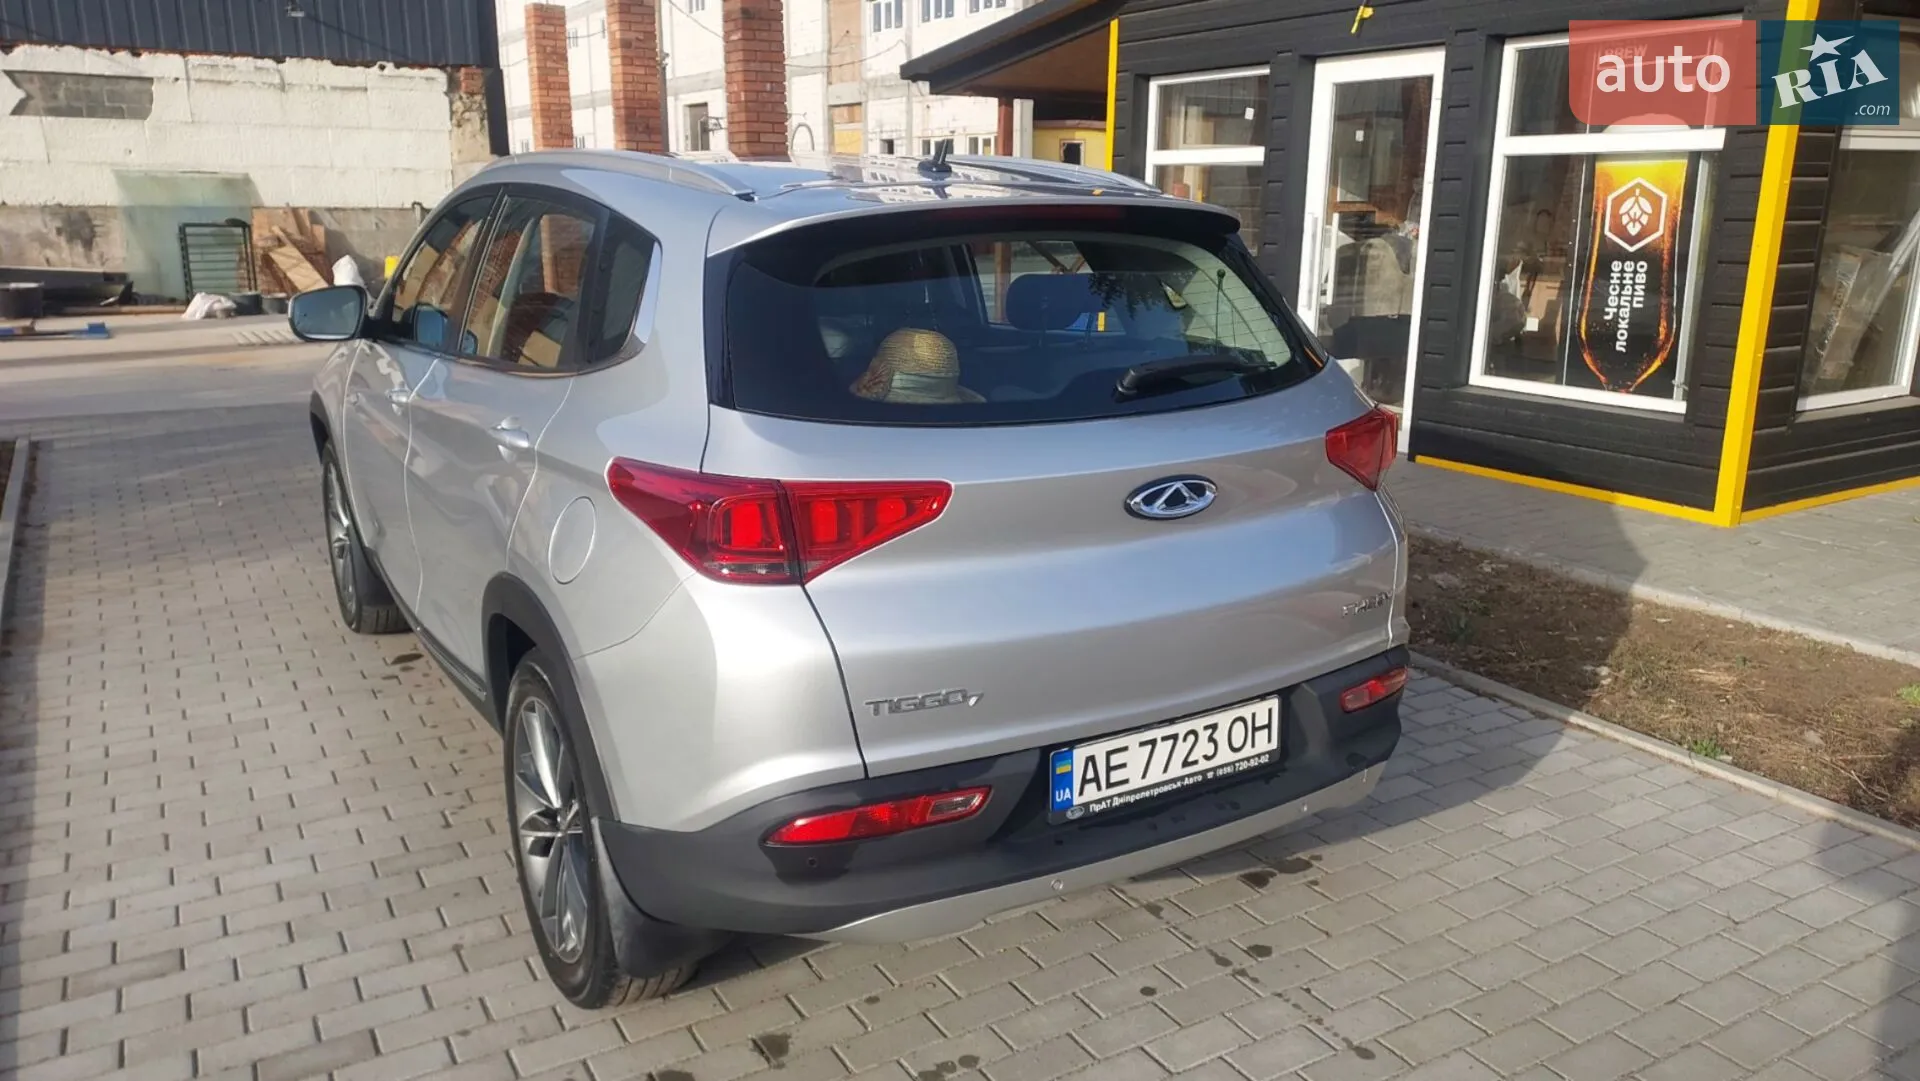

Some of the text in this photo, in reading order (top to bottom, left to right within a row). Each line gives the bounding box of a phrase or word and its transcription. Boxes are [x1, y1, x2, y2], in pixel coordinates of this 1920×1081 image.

[1604, 260, 1622, 320] Чесне
[1616, 260, 1635, 352] локальне
[1632, 261, 1648, 308] пиво
[1078, 707, 1272, 797] AE 7723 OH
[1056, 790, 1071, 802] UA
[1090, 800, 1111, 813] ПрАТ
